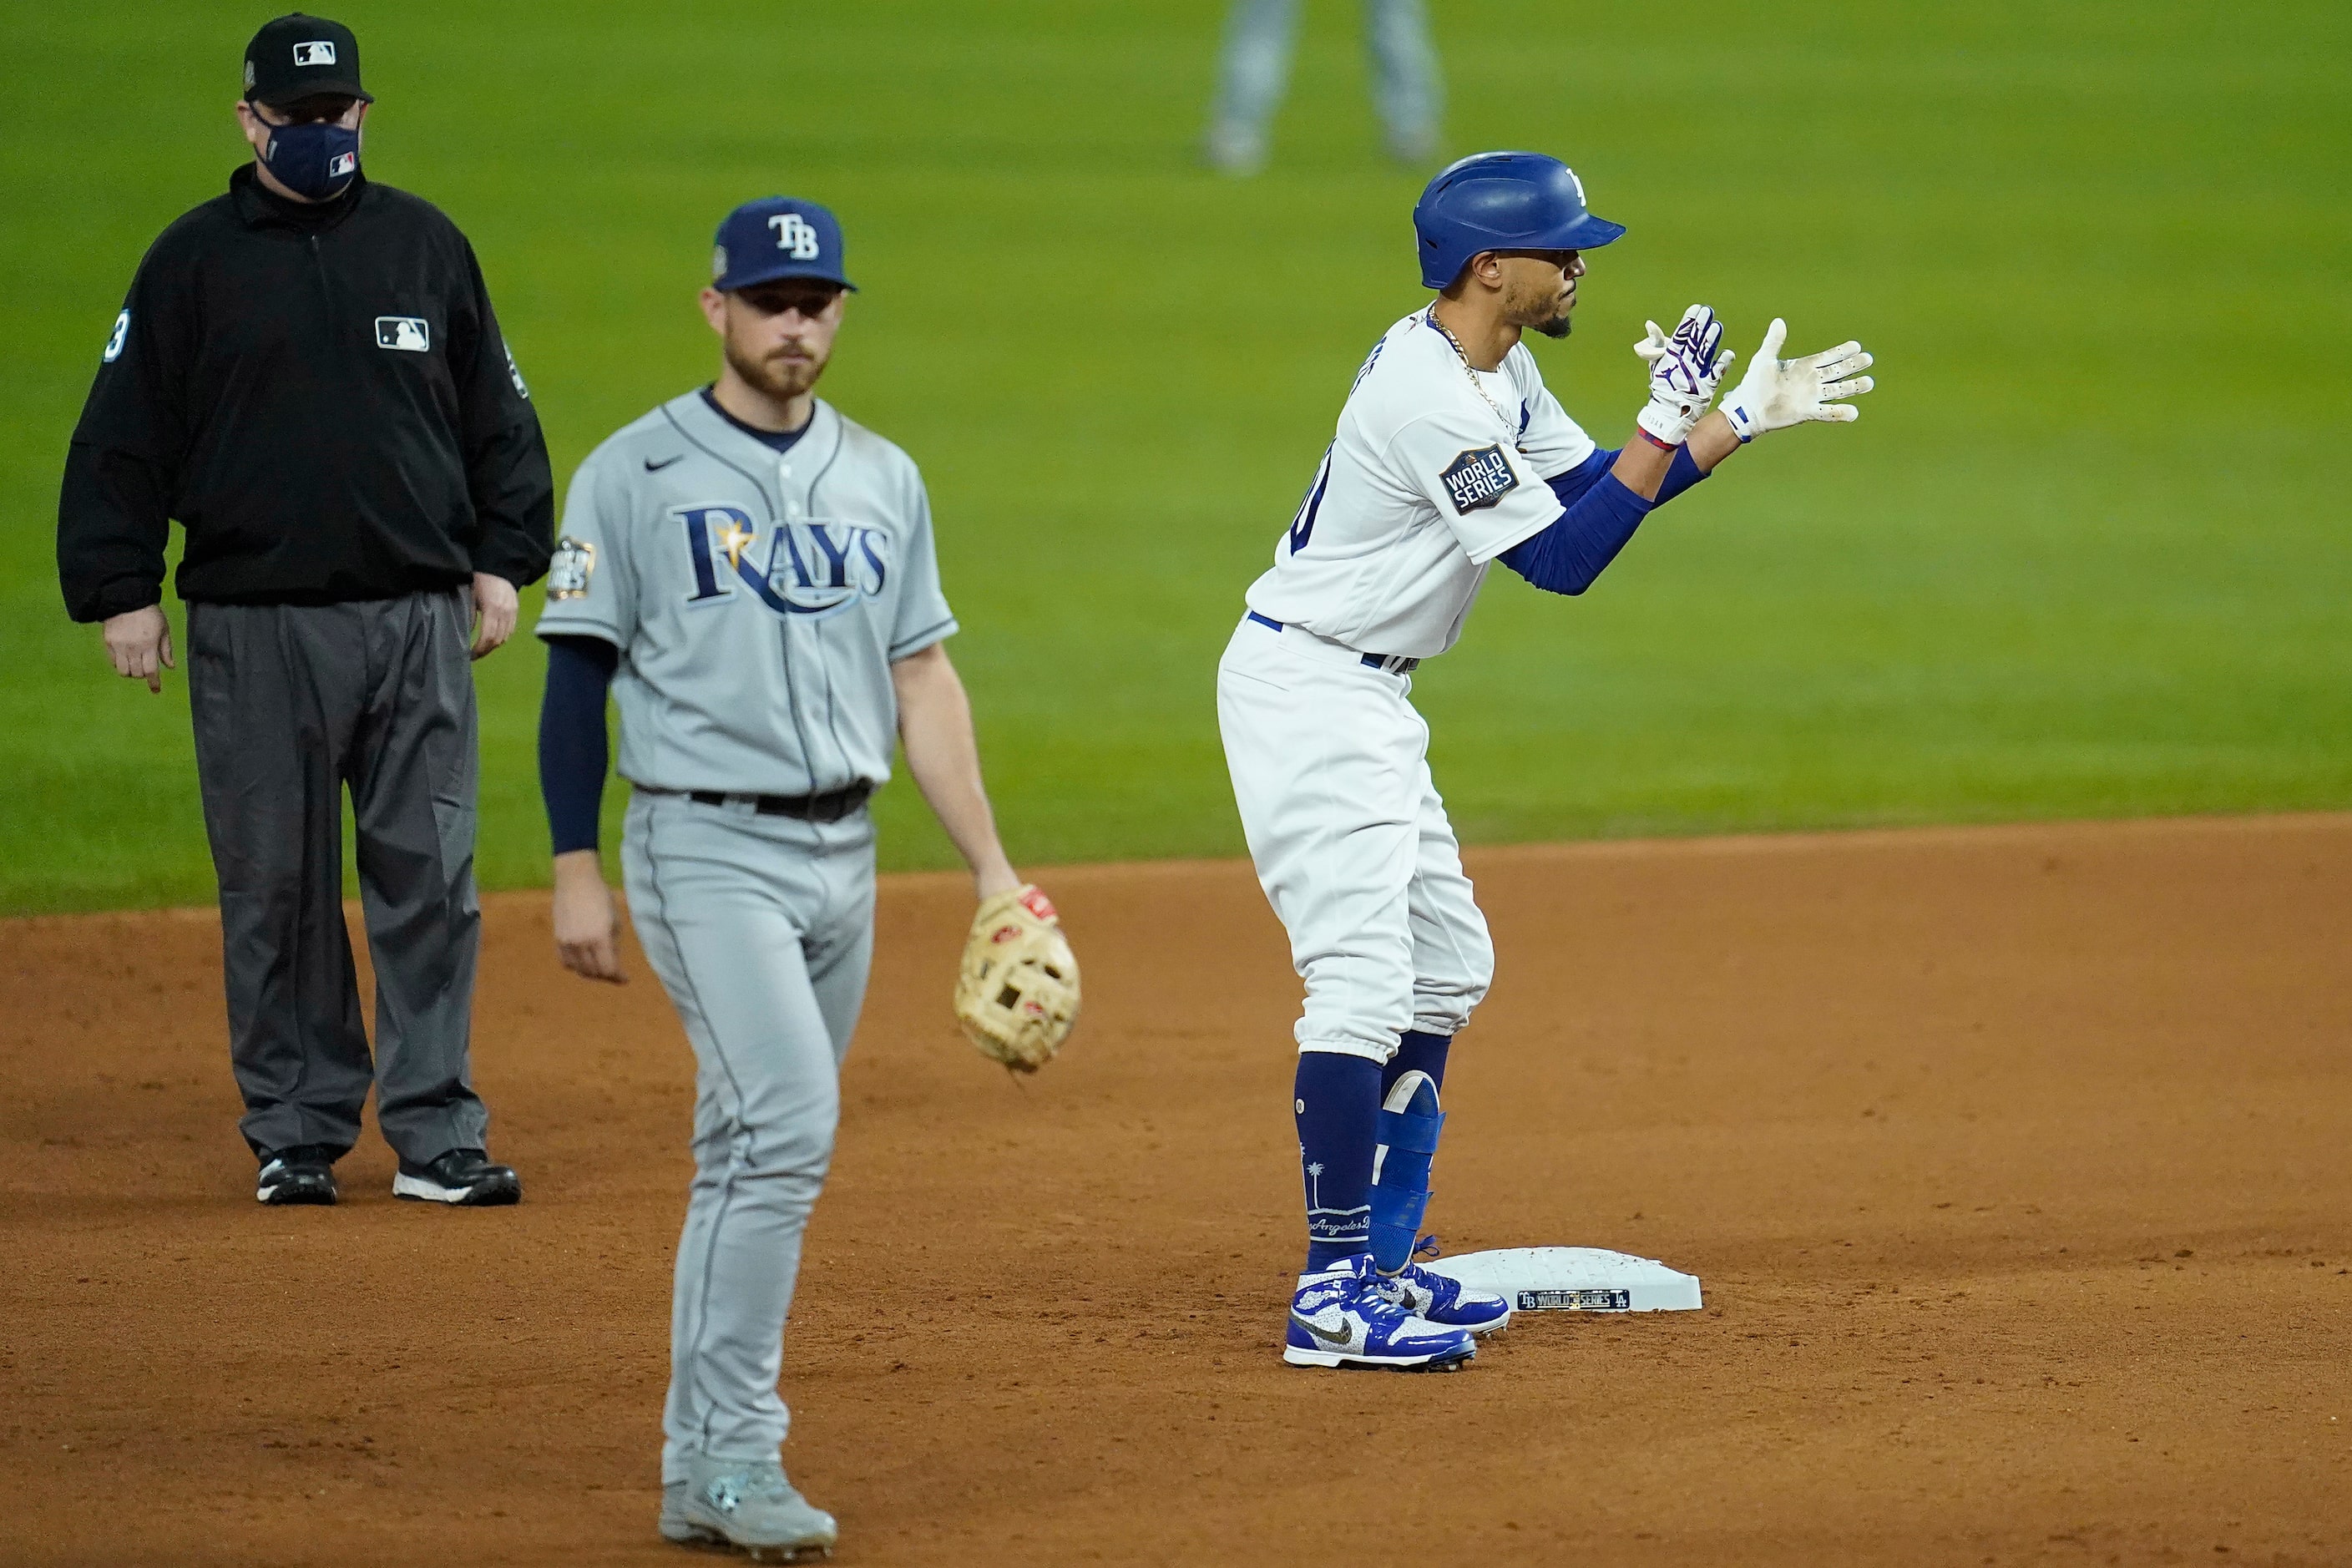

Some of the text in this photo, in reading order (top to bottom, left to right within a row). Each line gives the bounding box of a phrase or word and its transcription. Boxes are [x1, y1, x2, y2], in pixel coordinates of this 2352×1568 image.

[768, 213, 819, 260] TB
[1445, 452, 1504, 492] WORLD
[1454, 466, 1512, 508] SERIES
[666, 503, 893, 620] RAYS
[1519, 1292, 1627, 1308] TB WORLD SERIES LA
